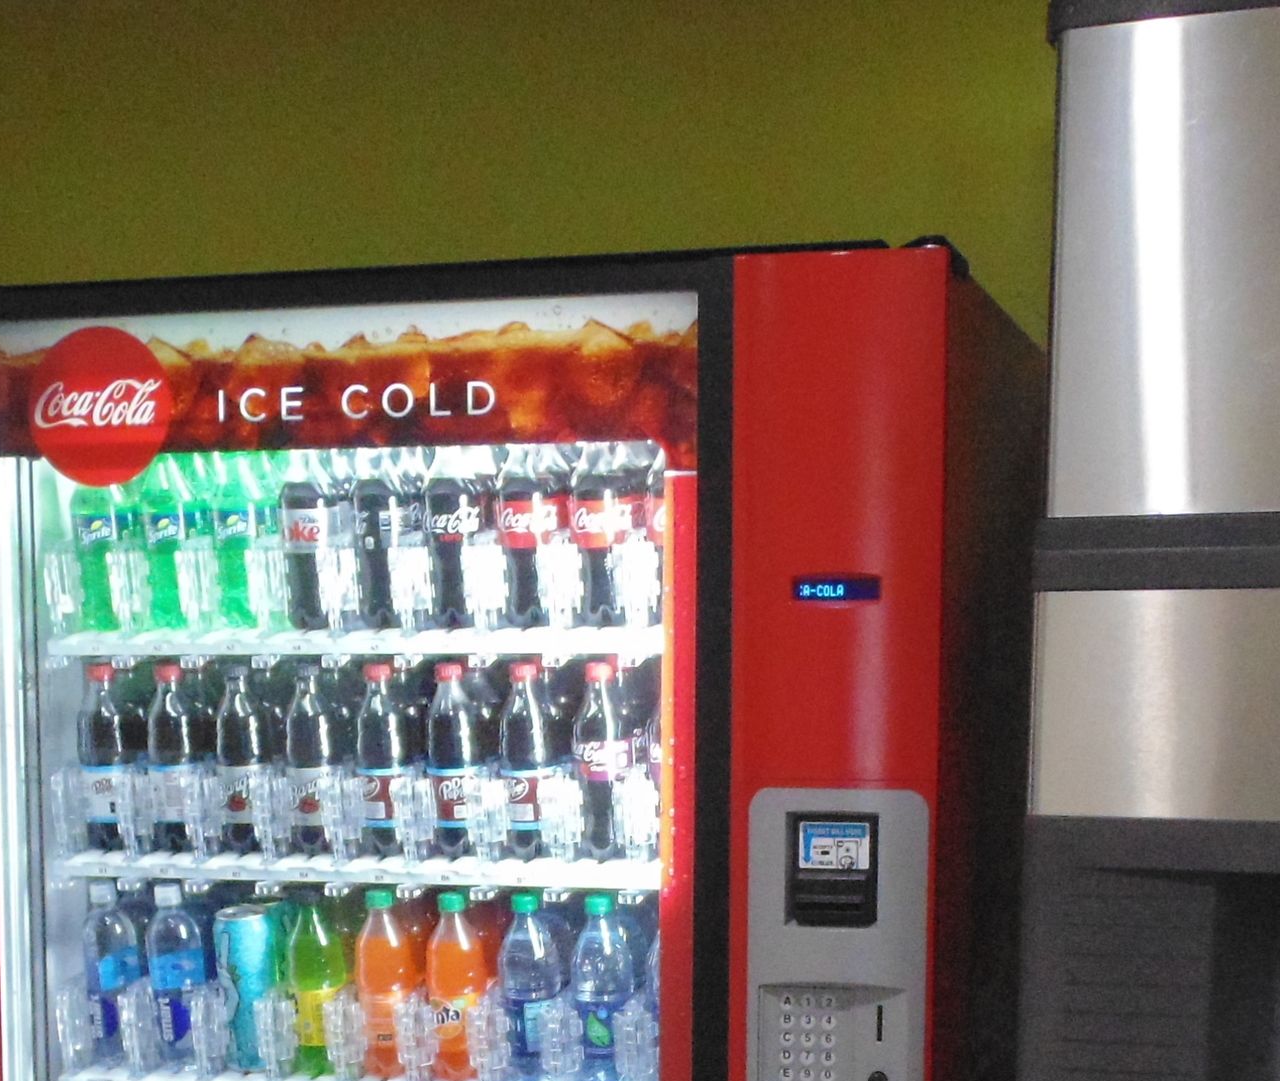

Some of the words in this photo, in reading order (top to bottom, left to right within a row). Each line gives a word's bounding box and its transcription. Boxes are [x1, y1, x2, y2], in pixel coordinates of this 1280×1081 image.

[34, 379, 162, 428] Coca-Cola
[218, 386, 304, 424] ICE
[341, 380, 496, 420] COLD
